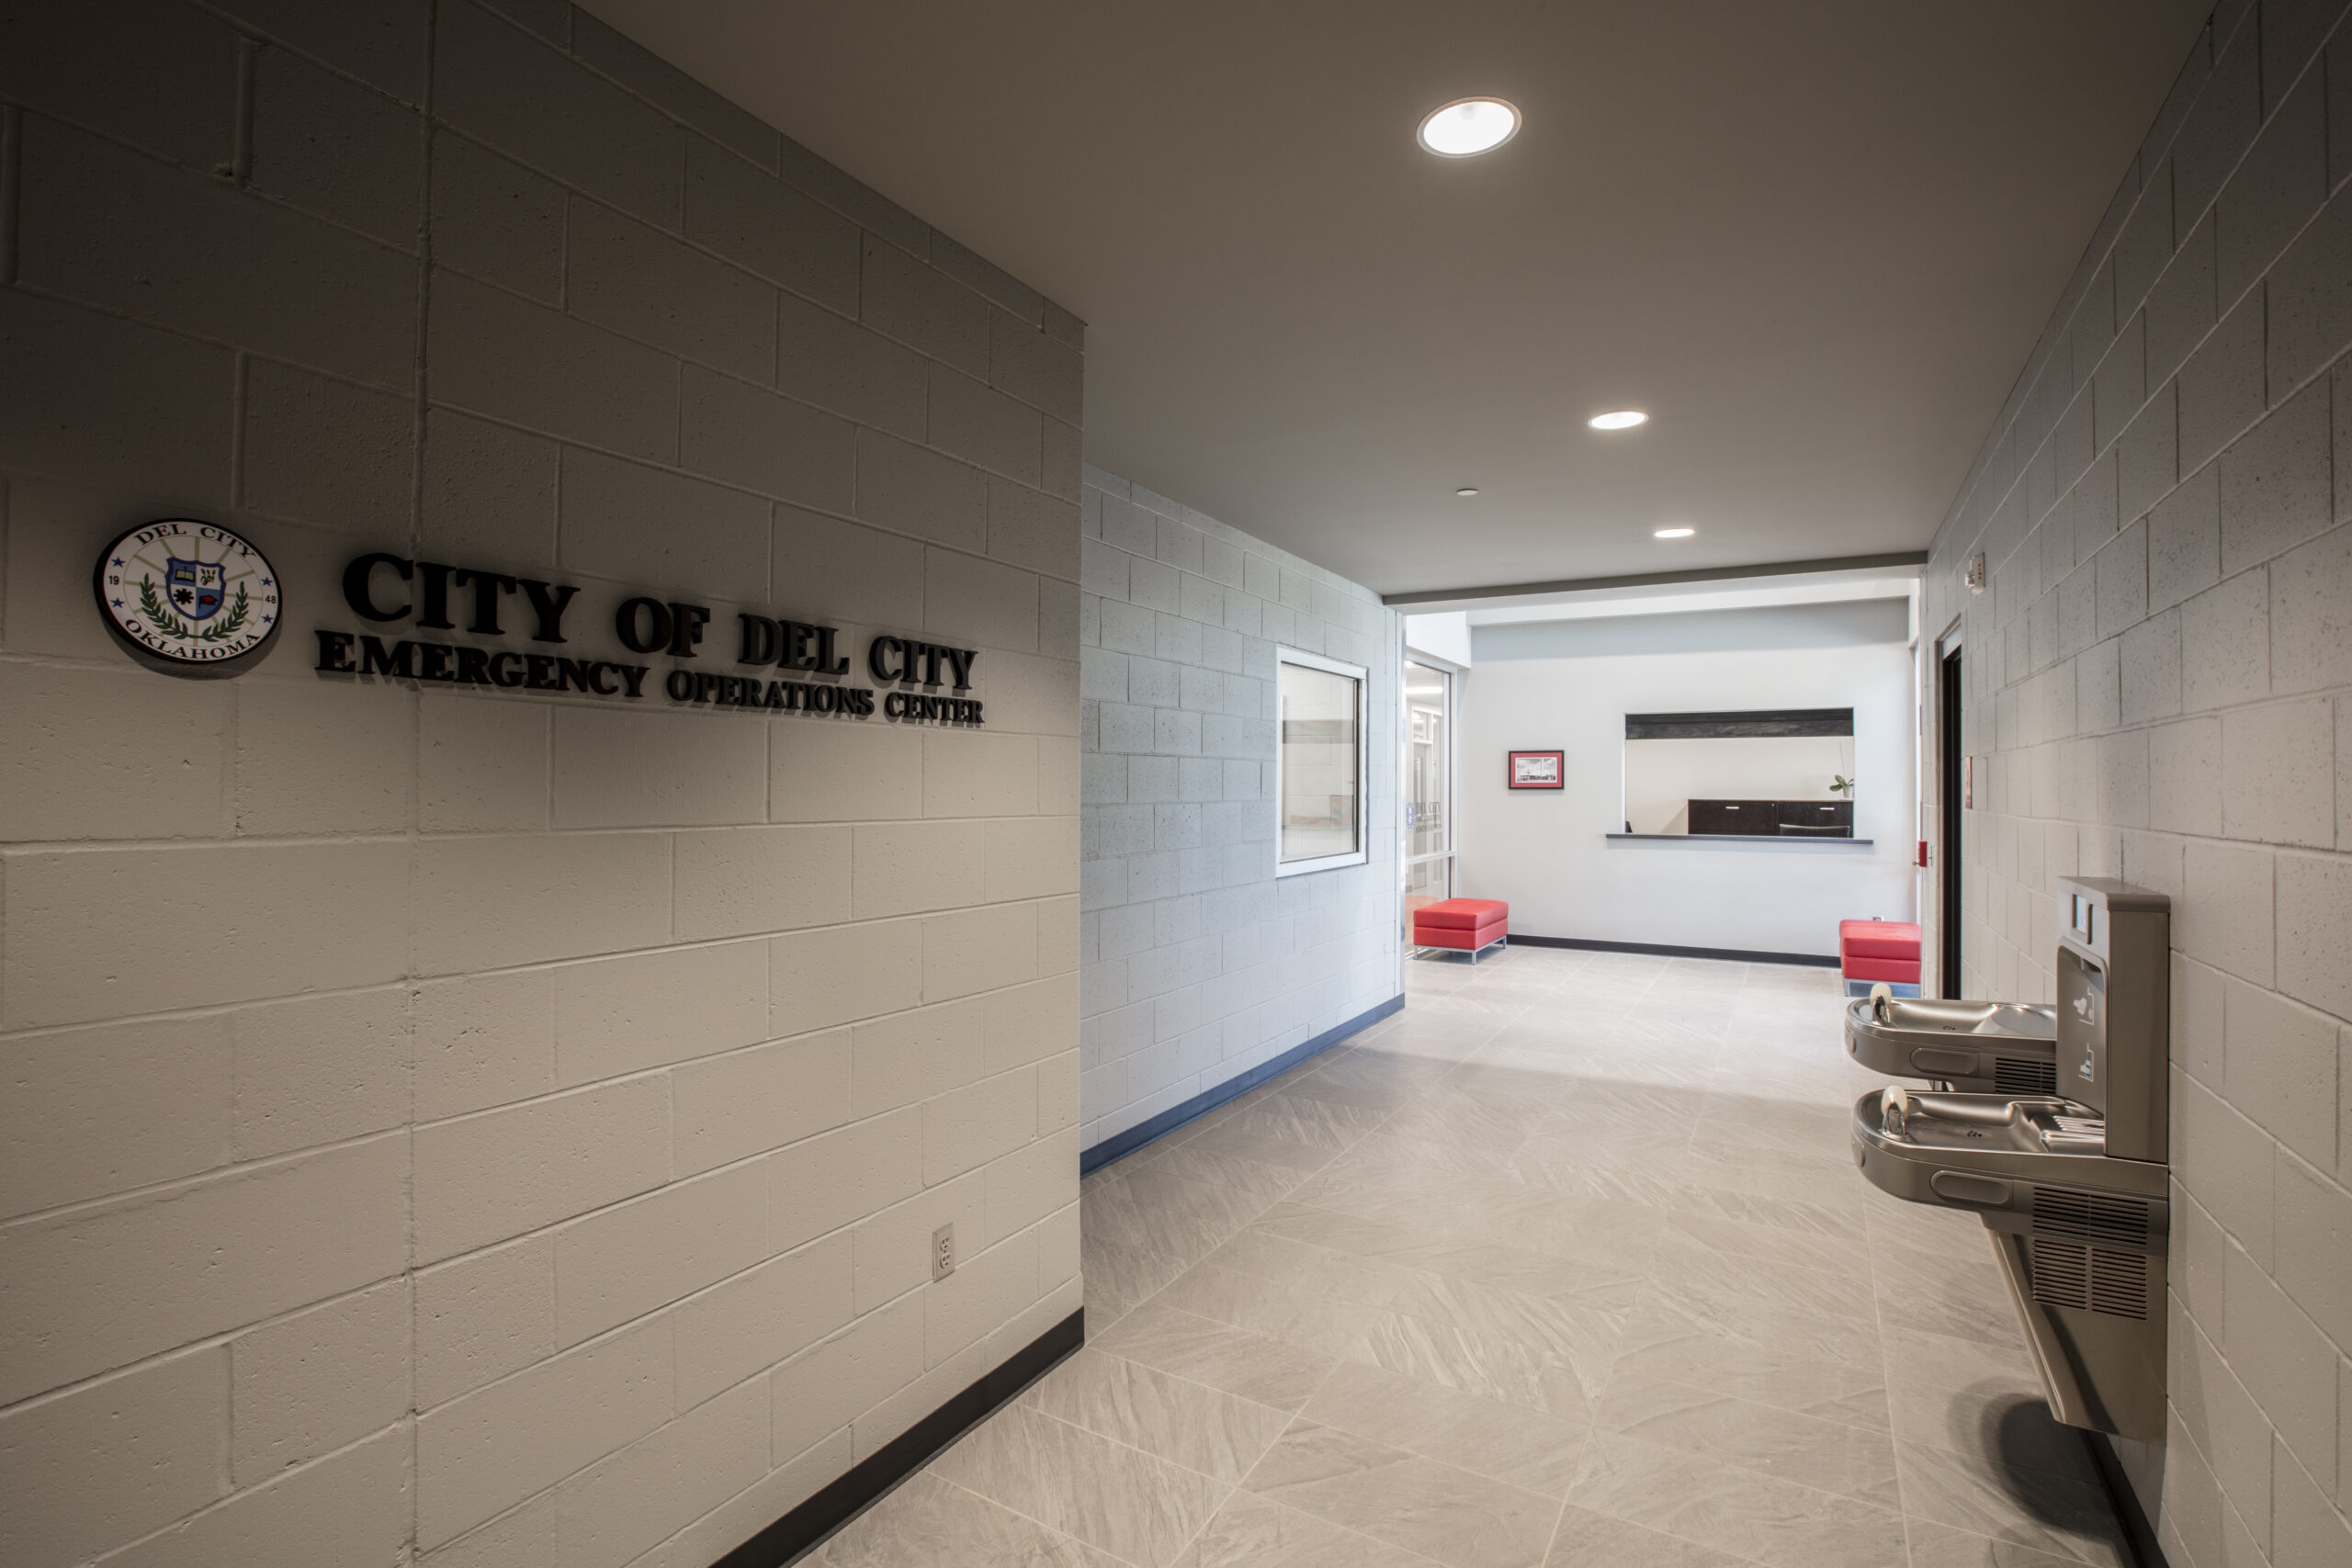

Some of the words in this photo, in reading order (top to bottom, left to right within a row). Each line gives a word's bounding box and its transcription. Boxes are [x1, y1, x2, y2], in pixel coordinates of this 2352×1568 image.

[134, 524, 187, 546] DEL
[199, 526, 256, 558] CITY
[108, 575, 119, 585] 19
[265, 595, 277, 604] 48
[125, 619, 260, 660] OKLAHOMA
[343, 553, 581, 643] CITY
[616, 597, 710, 658] OF
[738, 613, 850, 675] DEL
[868, 636, 978, 690] CITY
[314, 630, 650, 697] EMERGENCY
[666, 671, 875, 716] OPERATIONS
[884, 692, 985, 724] CENTER
